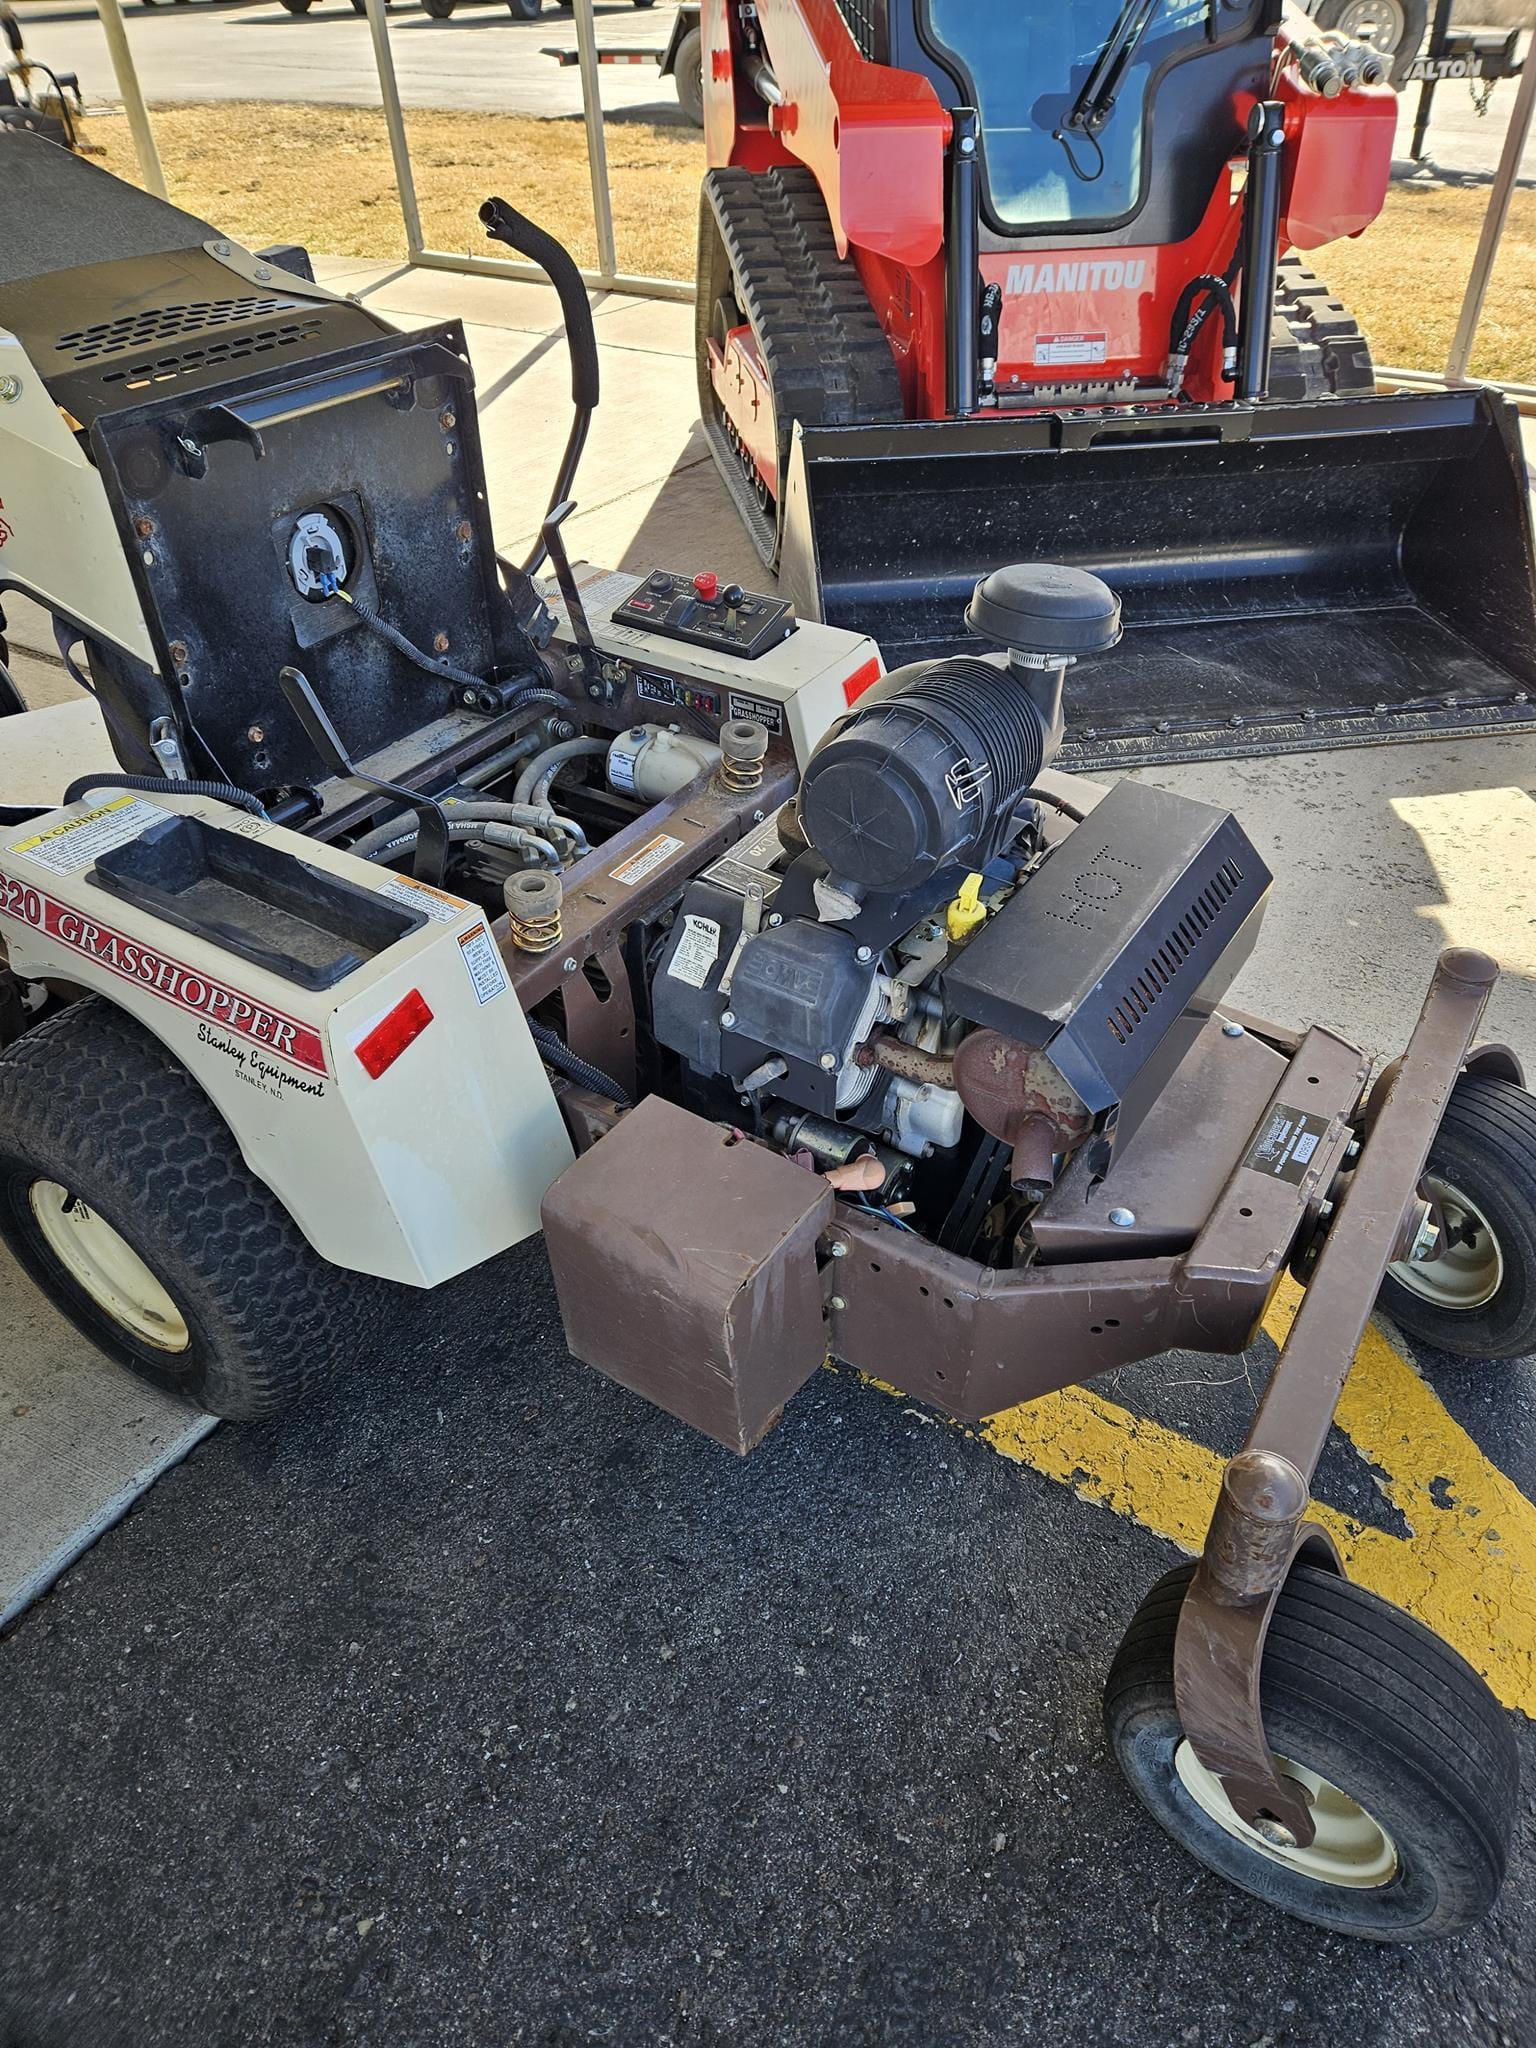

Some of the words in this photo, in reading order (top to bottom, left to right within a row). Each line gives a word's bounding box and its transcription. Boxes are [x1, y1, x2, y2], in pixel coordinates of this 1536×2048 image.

[1403, 57, 1482, 80] ALTON
[1006, 260, 1145, 294] MANITOU
[734, 706, 774, 726] GRASSHOPPER
[52, 808, 113, 836] CAUTION
[1045, 845, 1142, 931] HOT
[691, 917, 717, 936] KOHLER
[57, 913, 298, 1055] GRASSHOPPER
[198, 1022, 245, 1068] Stanley
[251, 1050, 325, 1098] Equipment
[234, 1069, 268, 1094] STANLEY,
